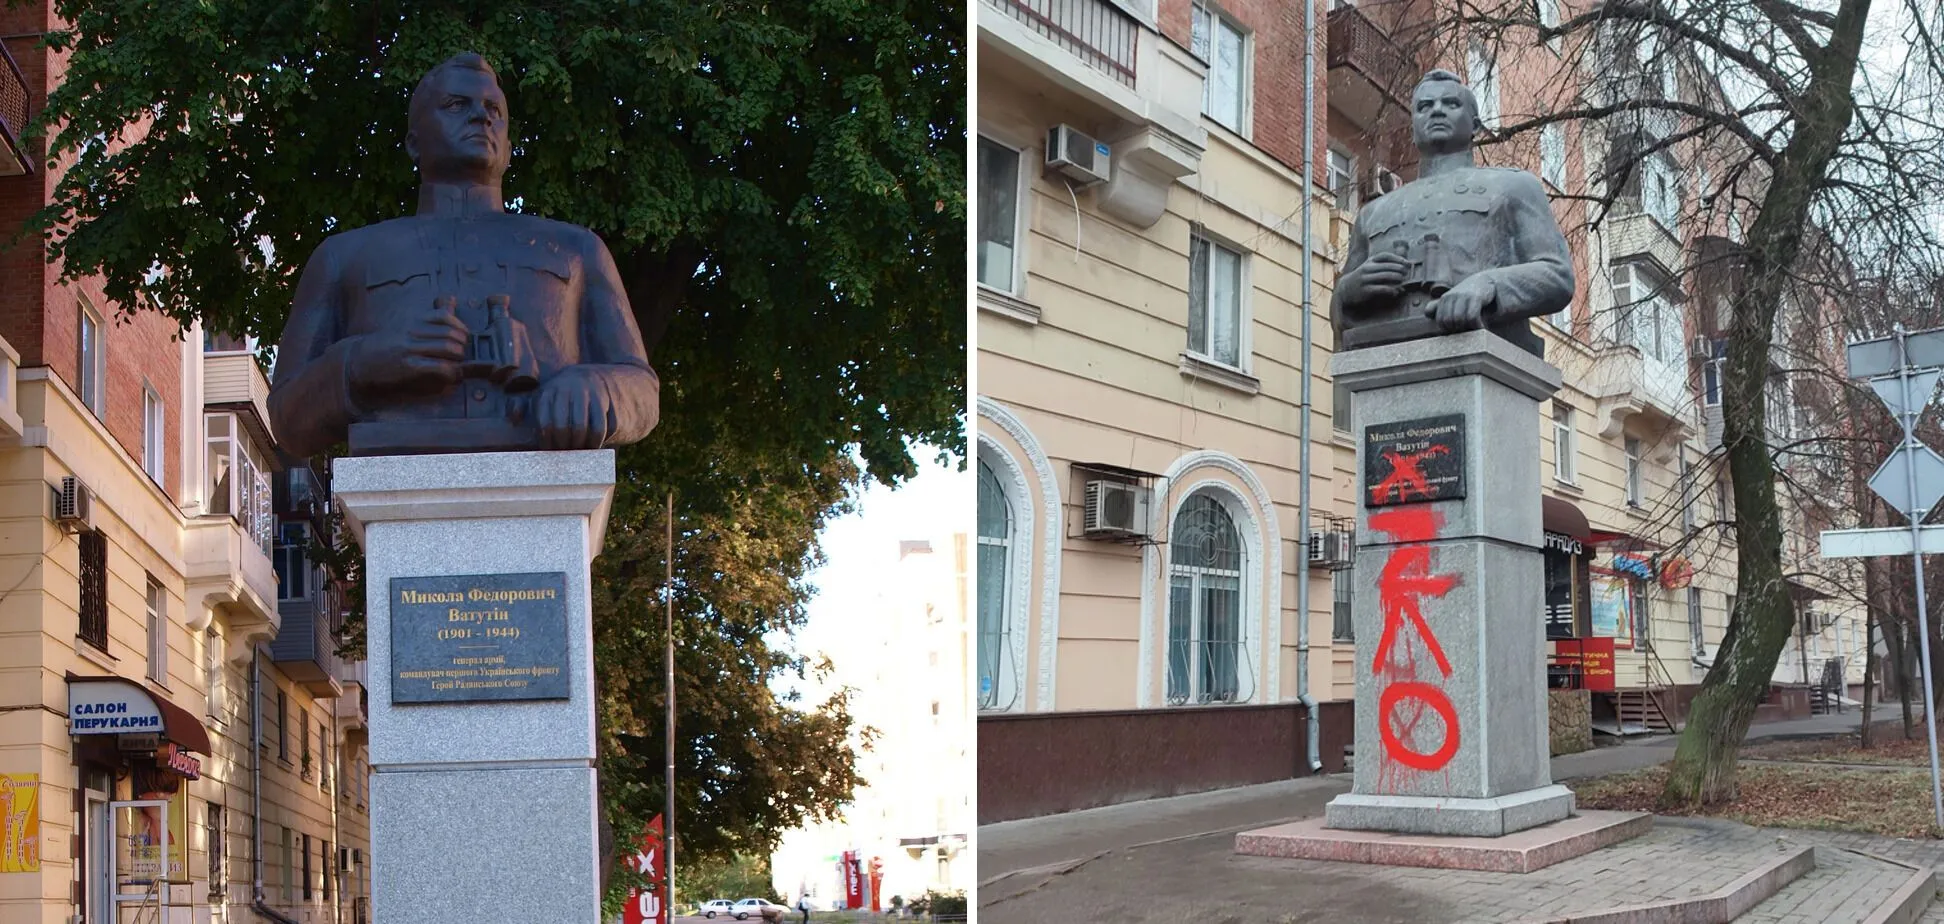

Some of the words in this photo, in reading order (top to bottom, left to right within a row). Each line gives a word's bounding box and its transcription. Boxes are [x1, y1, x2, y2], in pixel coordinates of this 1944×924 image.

[1545, 532, 1582, 555] АРАДИЗ
[400, 590, 464, 604] Микола
[468, 588, 556, 605] Федорович
[448, 607, 509, 625] Ватутін
[438, 628, 471, 640] (1901
[485, 627, 520, 639] 1944)
[75, 702, 127, 715] САЛОН
[75, 715, 159, 729] ПЕРУКАРНЯ
